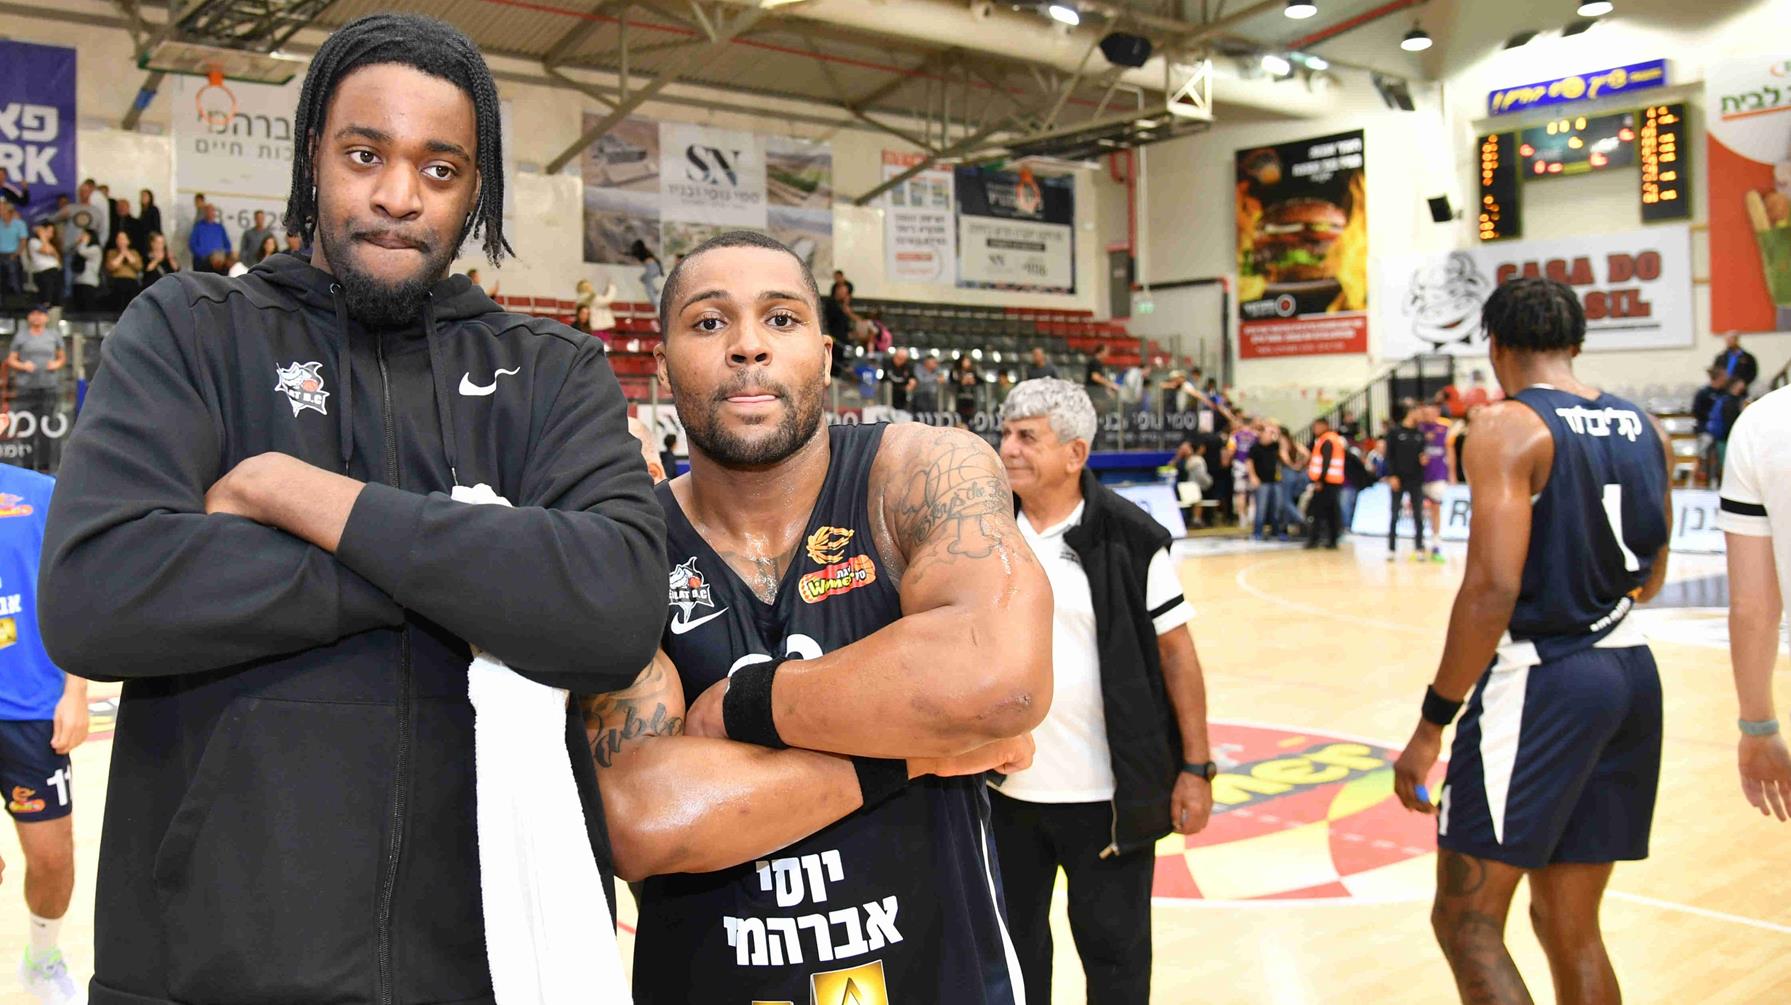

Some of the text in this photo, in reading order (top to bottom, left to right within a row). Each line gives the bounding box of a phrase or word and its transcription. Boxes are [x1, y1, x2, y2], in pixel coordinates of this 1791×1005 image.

[1721, 87, 1780, 113] לבית
[0, 103, 59, 142] פא
[197, 109, 291, 141] ברהמי
[0, 142, 58, 185] RK
[1496, 251, 1661, 287] CASA DO
[1584, 288, 1651, 320] SIL
[1601, 484, 1640, 572] 1
[755, 849, 845, 908] יוסי
[723, 895, 904, 966] אברהמי
